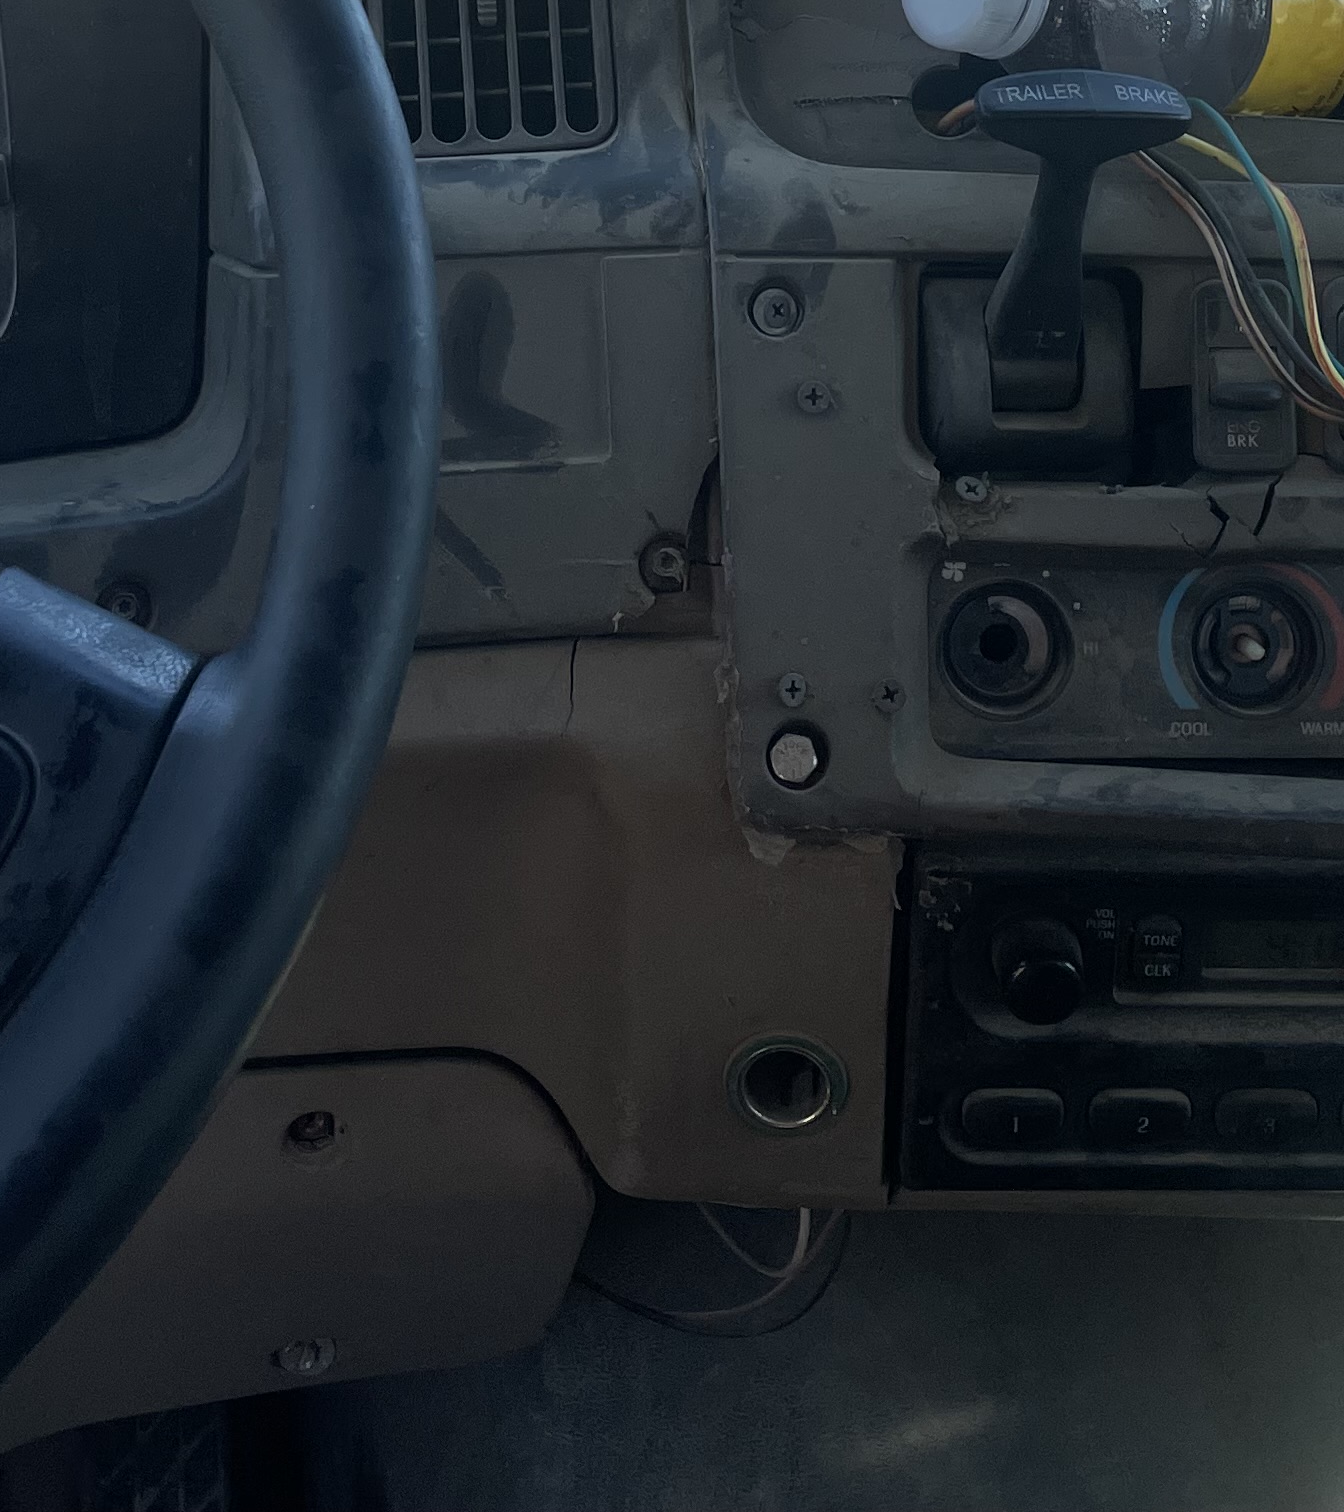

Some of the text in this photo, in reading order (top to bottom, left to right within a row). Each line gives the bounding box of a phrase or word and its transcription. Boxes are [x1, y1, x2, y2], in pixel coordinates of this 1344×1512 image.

[995, 84, 1182, 107] TRAILER BRAKE
[1227, 434, 1259, 447] BRK
[1083, 642, 1099, 655] HI
[1170, 722, 1212, 738] COOL
[1095, 908, 1115, 918] VOL
[1086, 919, 1115, 929] PUSH
[1144, 934, 1178, 946] TONE
[1144, 964, 1171, 977] CLK
[1011, 1117, 1019, 1134] 1
[1137, 1117, 1149, 1134] 2
